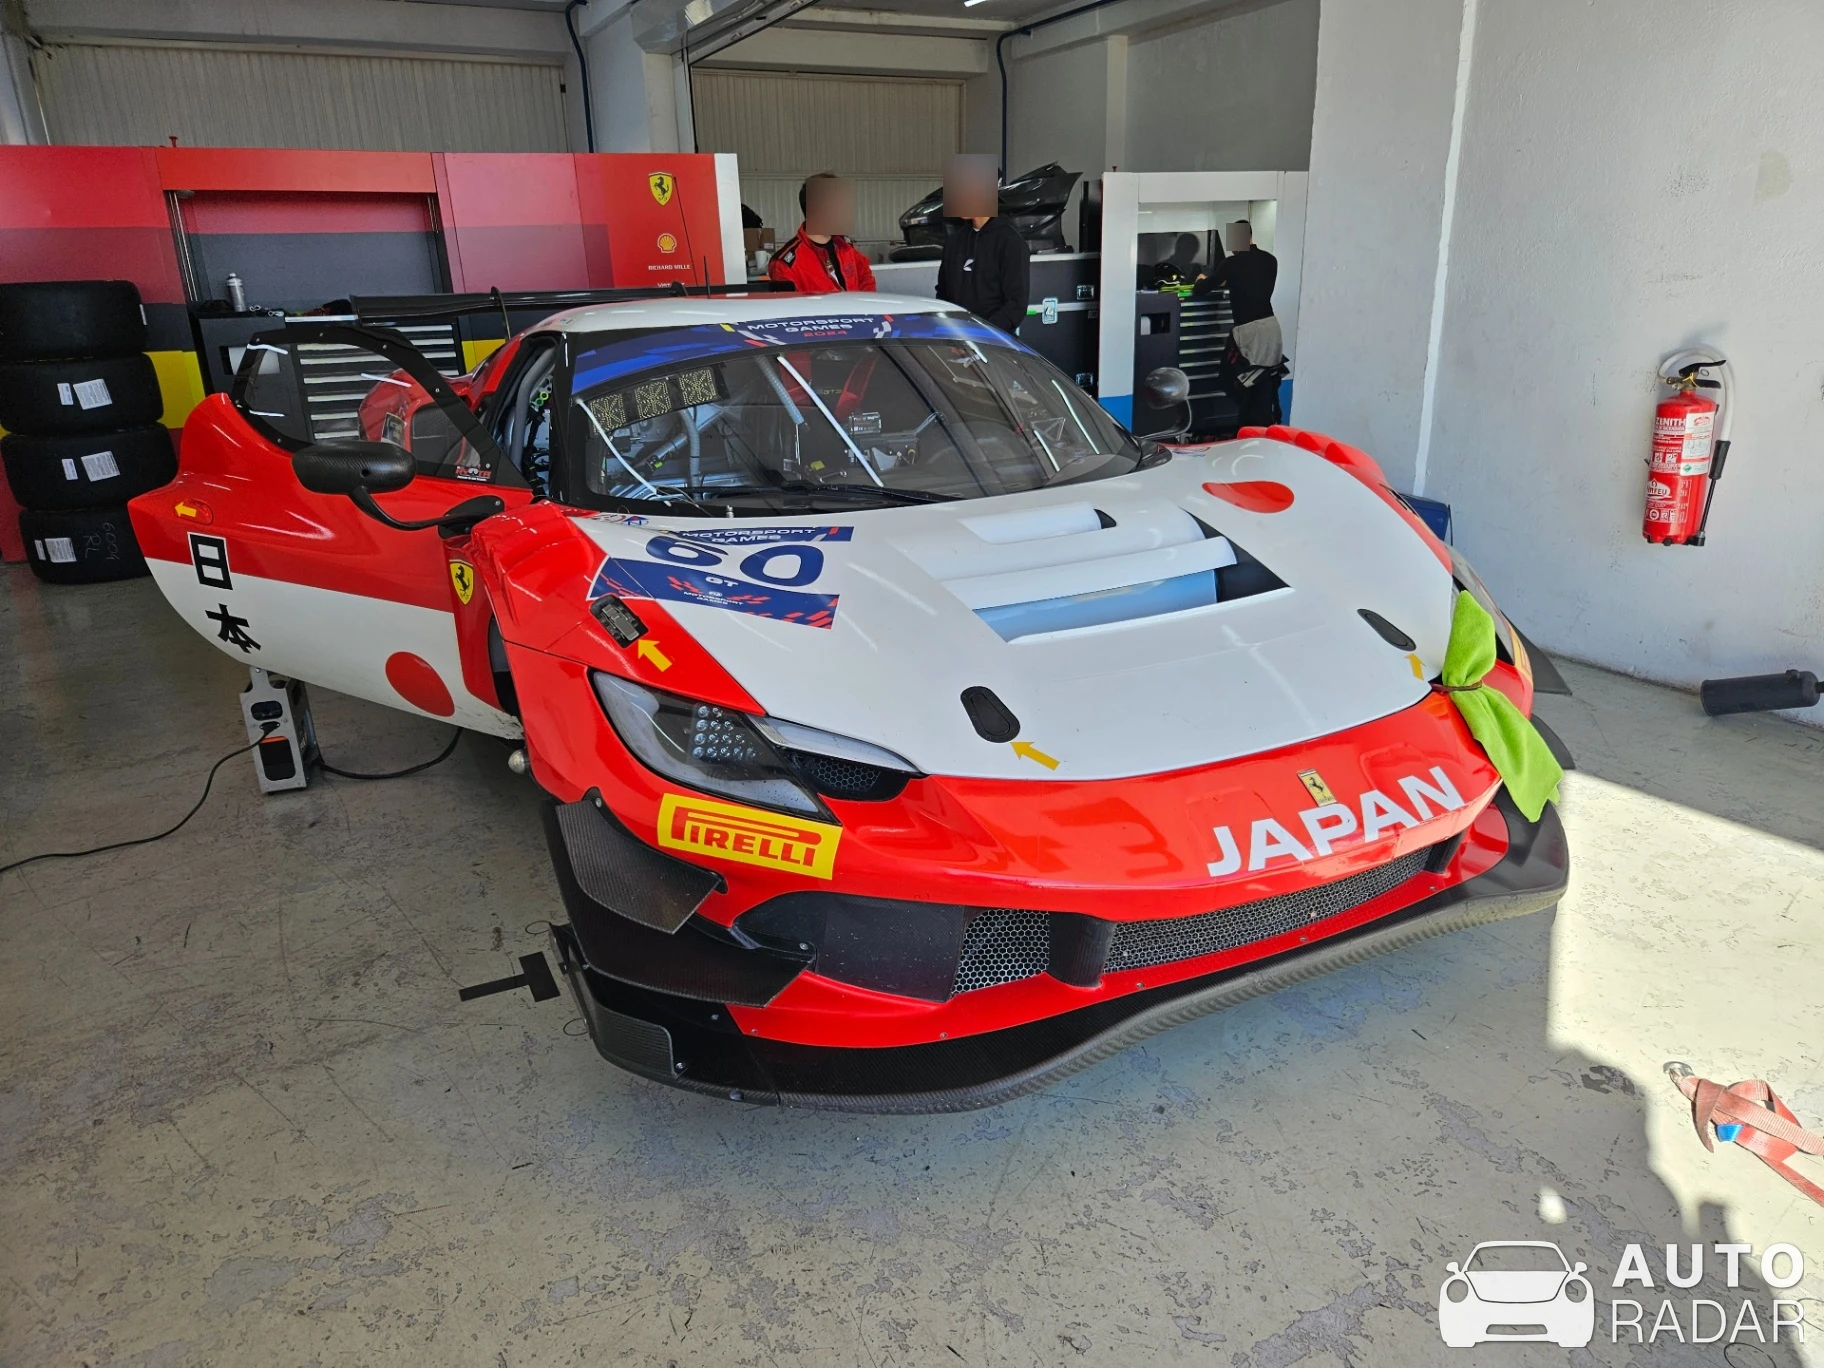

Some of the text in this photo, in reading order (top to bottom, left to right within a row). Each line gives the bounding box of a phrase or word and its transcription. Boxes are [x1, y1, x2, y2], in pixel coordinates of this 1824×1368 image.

[747, 317, 875, 331] MOTORSPORT
[785, 324, 853, 333] GAMES
[1655, 417, 1686, 427] ZENITH
[682, 528, 816, 538] MOTORSPORT
[711, 534, 782, 543] GAMES
[645, 535, 825, 587] 60
[705, 576, 739, 588] GT
[187, 531, 262, 655] 日本
[683, 591, 744, 606] MOTORSPORT
[696, 597, 729, 605] GAMES
[1206, 765, 1466, 877] JAPAN
[670, 805, 823, 867] PIRELLI
